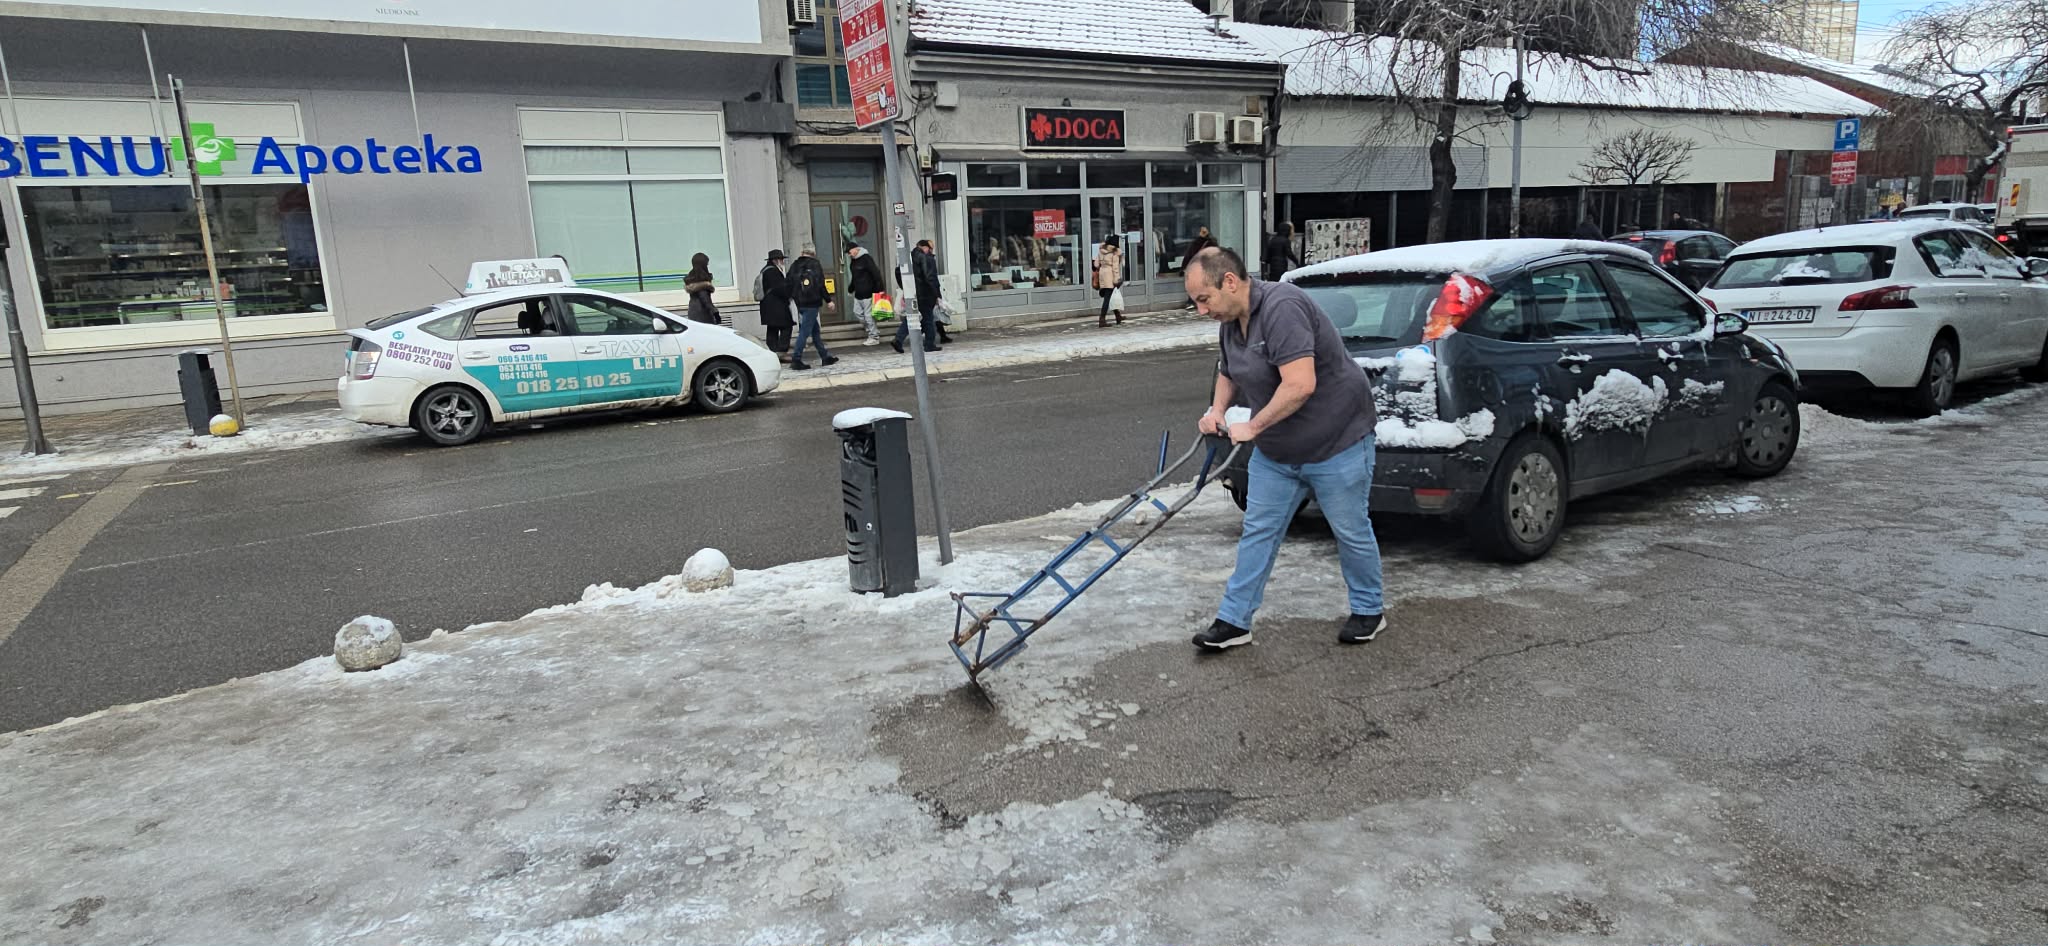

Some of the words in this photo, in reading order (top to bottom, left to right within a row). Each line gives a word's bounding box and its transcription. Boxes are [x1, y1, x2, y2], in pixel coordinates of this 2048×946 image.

[1054, 117, 1120, 139] DOCA
[1840, 121, 1855, 138] P
[251, 133, 482, 183] Apoteka
[1749, 312, 1763, 321] NI
[389, 342, 430, 355] BESPLATNI
[431, 350, 454, 361] POZIV
[599, 339, 661, 357] TAXI
[386, 348, 412, 361] 0800
[412, 354, 432, 366] 252
[433, 358, 452, 370] 000
[632, 355, 679, 370] LIFT
[516, 379, 552, 394] 018
[555, 376, 580, 391] 25
[584, 374, 605, 388] 10
[608, 372, 632, 386] 25
